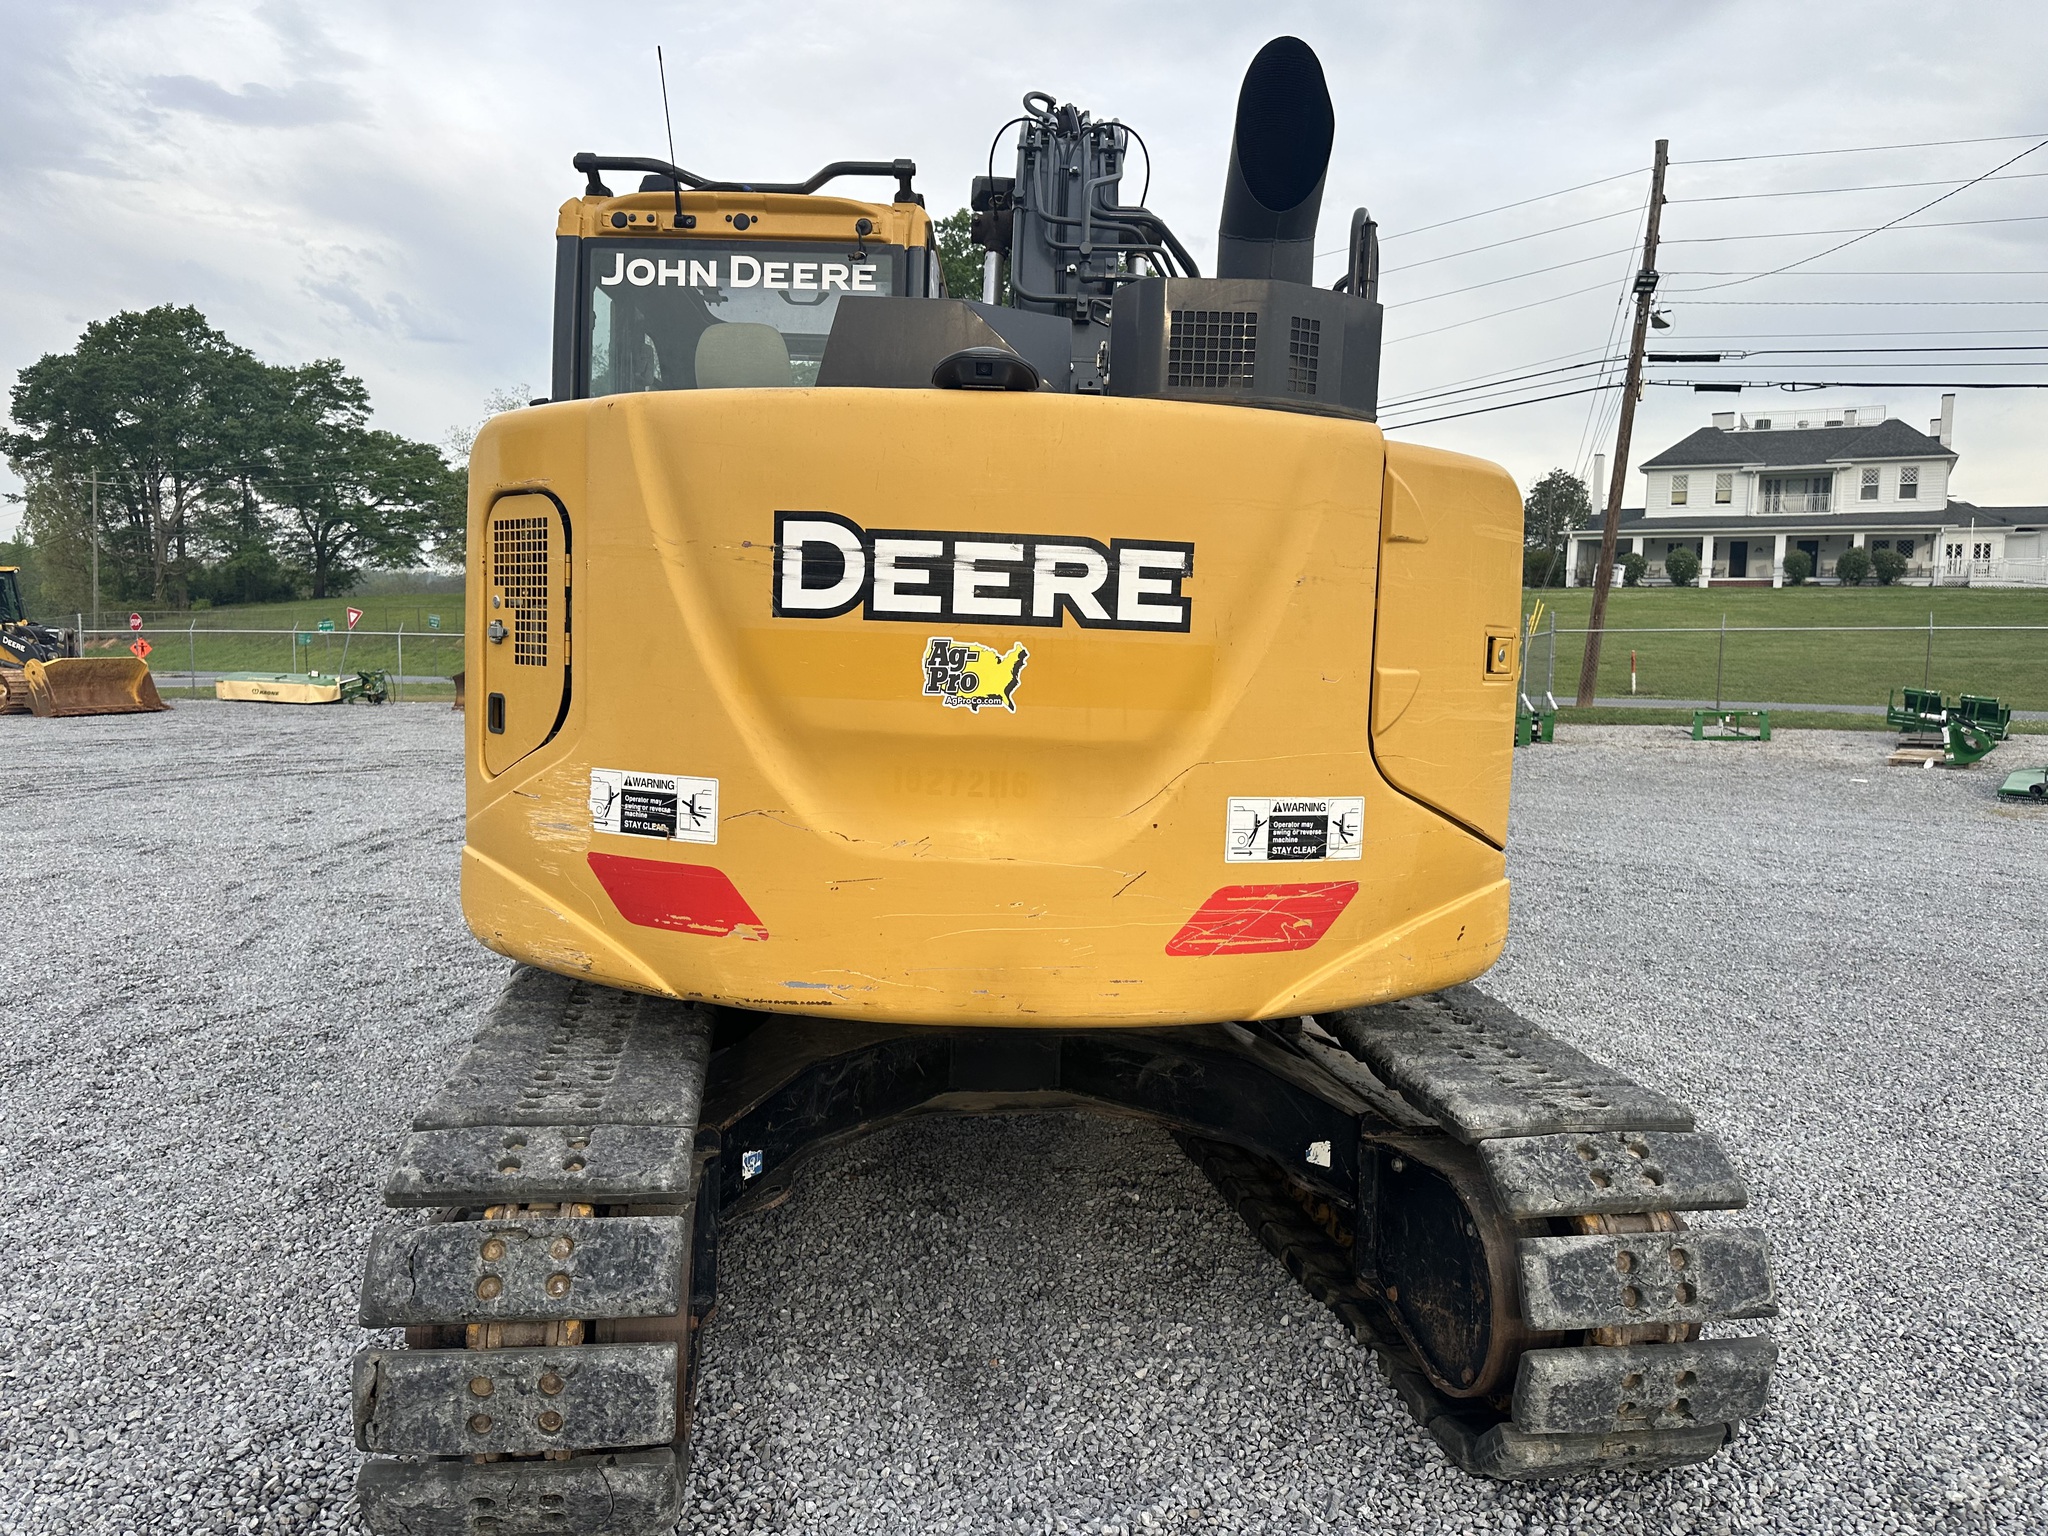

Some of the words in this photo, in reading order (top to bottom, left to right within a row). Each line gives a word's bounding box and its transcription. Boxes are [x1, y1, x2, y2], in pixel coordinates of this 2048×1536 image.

[601, 252, 717, 287] JOHN
[730, 255, 878, 291] DEERE
[778, 515, 1190, 628] DEERE
[2, 635, 26, 653] DEERE
[926, 639, 979, 672] Ag-
[926, 666, 979, 694] Pro
[945, 696, 1003, 707] AgProCo.com
[632, 777, 675, 790] WARNING
[624, 794, 649, 804] Operator
[650, 797, 663, 806] may
[624, 803, 642, 812] swing
[1283, 802, 1326, 812] WARNING
[624, 820, 642, 829] STAY
[642, 822, 667, 831] CLEAR
[1273, 821, 1300, 829] Operator
[1272, 846, 1291, 854] STAY
[1293, 846, 1317, 854] CLEAR
